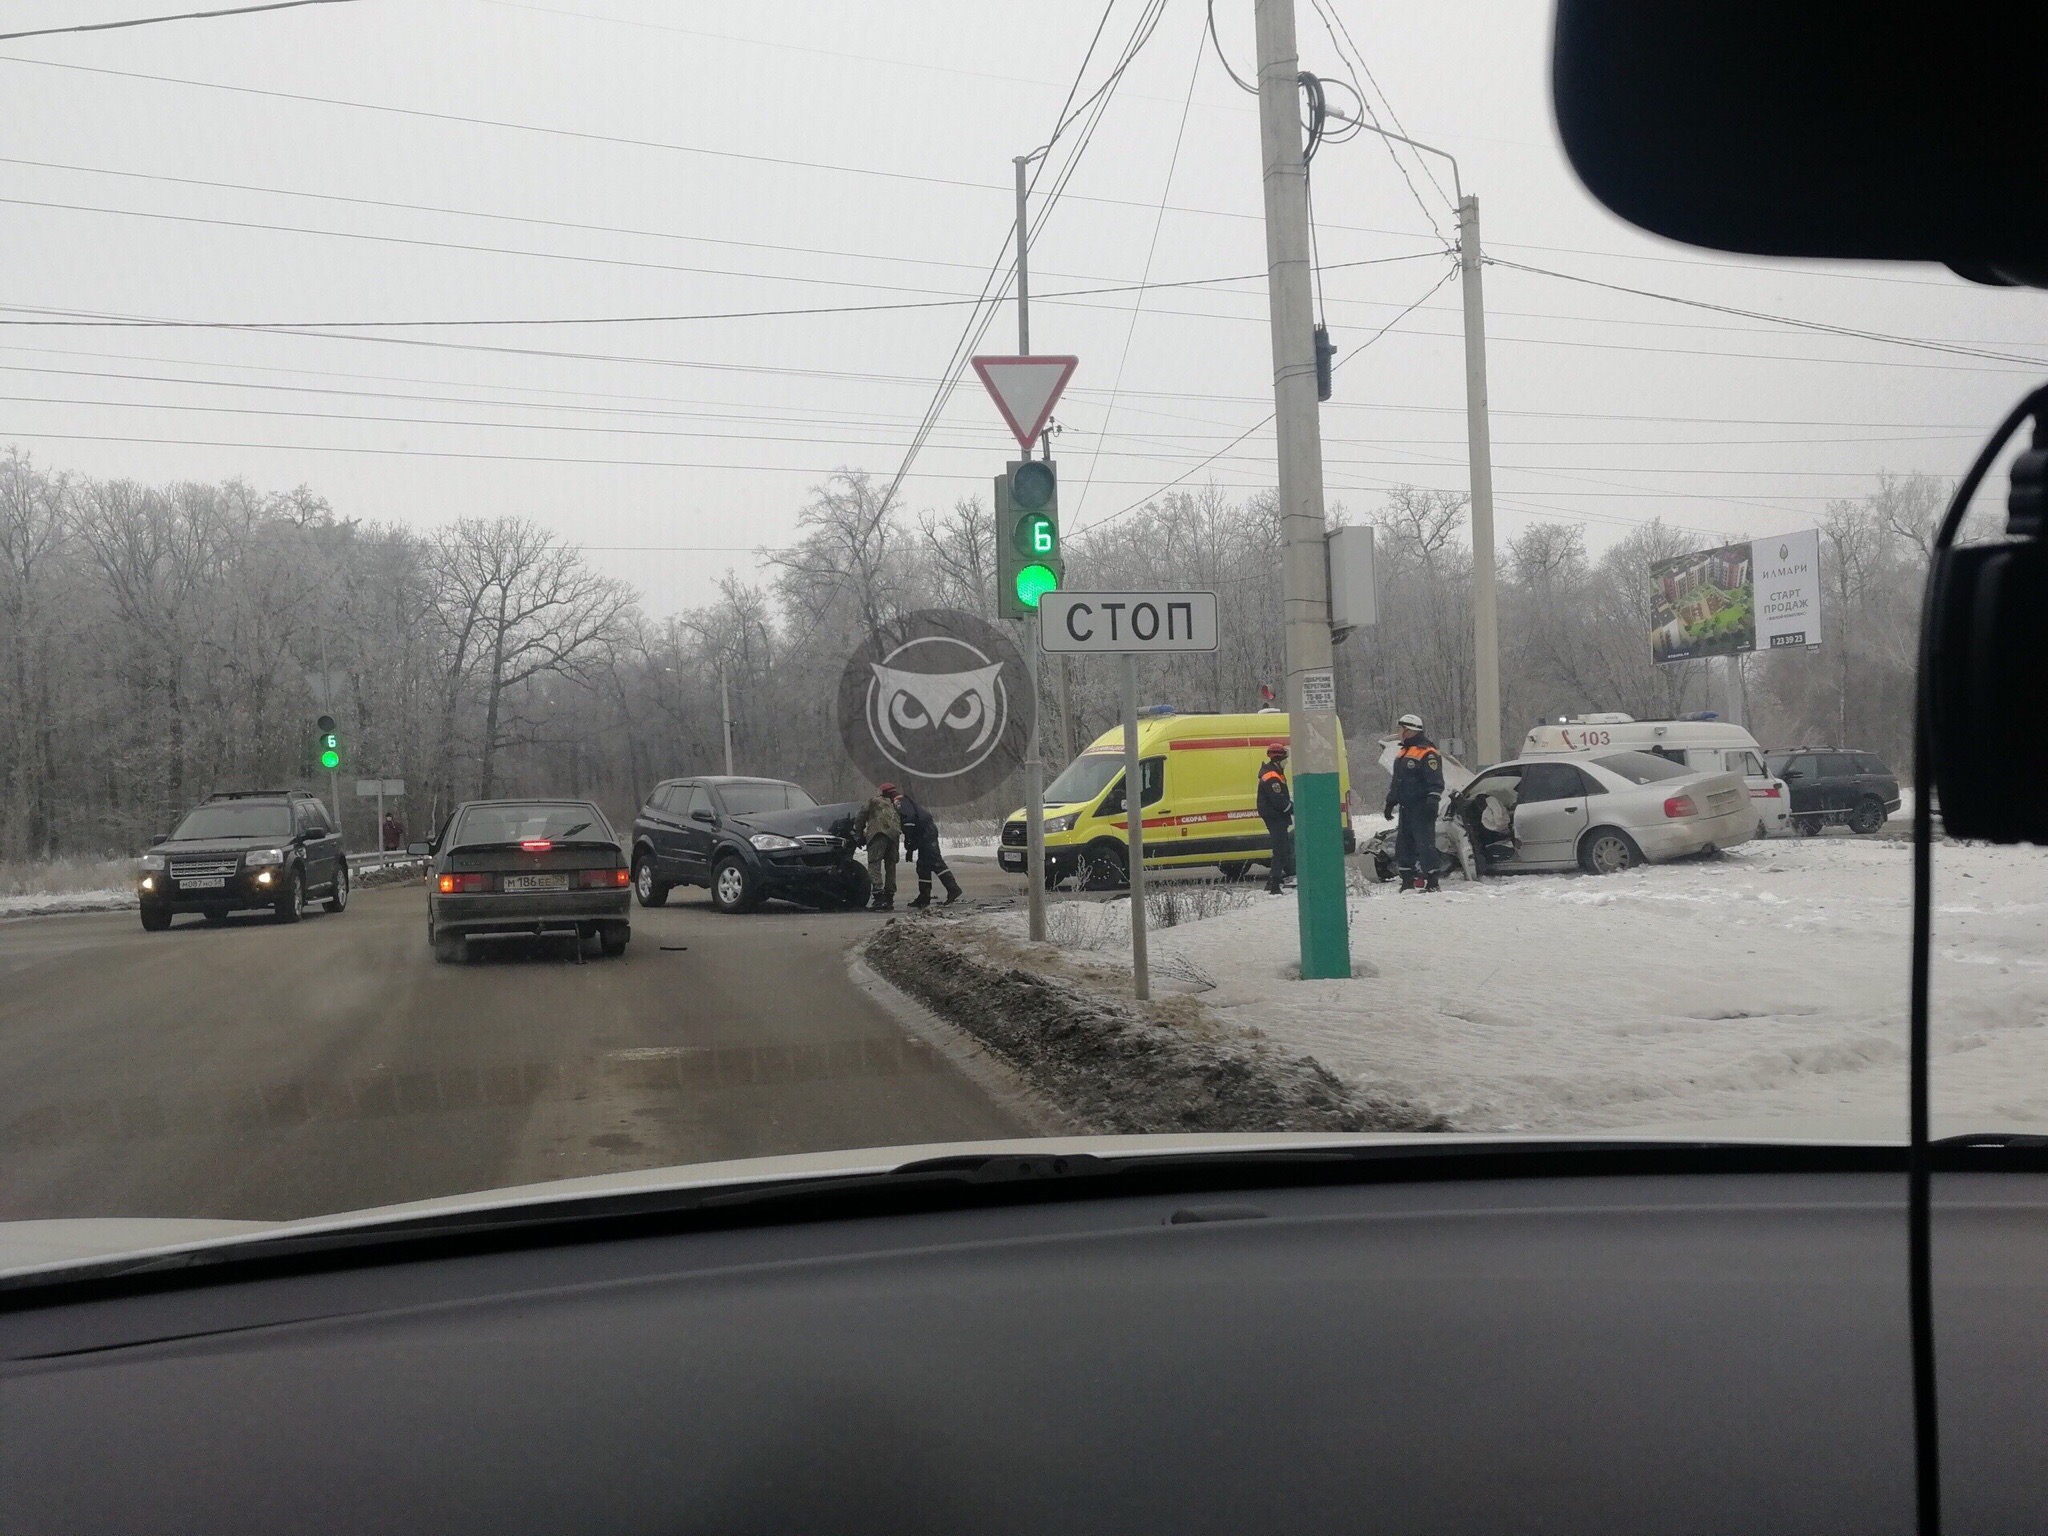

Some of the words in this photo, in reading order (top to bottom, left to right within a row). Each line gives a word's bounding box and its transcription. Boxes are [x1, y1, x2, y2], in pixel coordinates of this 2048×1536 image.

[1034, 521, 1051, 551] 6
[1762, 564, 1808, 579] ИЛМАРИ
[1770, 588, 1801, 601] СТАРТ
[1764, 599, 1809, 614] ПРОДАЖ
[1066, 602, 1193, 642] СТОП
[327, 735, 336, 748] 6
[1579, 731, 1611, 746] 103
[1181, 814, 1207, 823] СКОРАЯ
[1227, 810, 1259, 819] МЕДИЦИН
